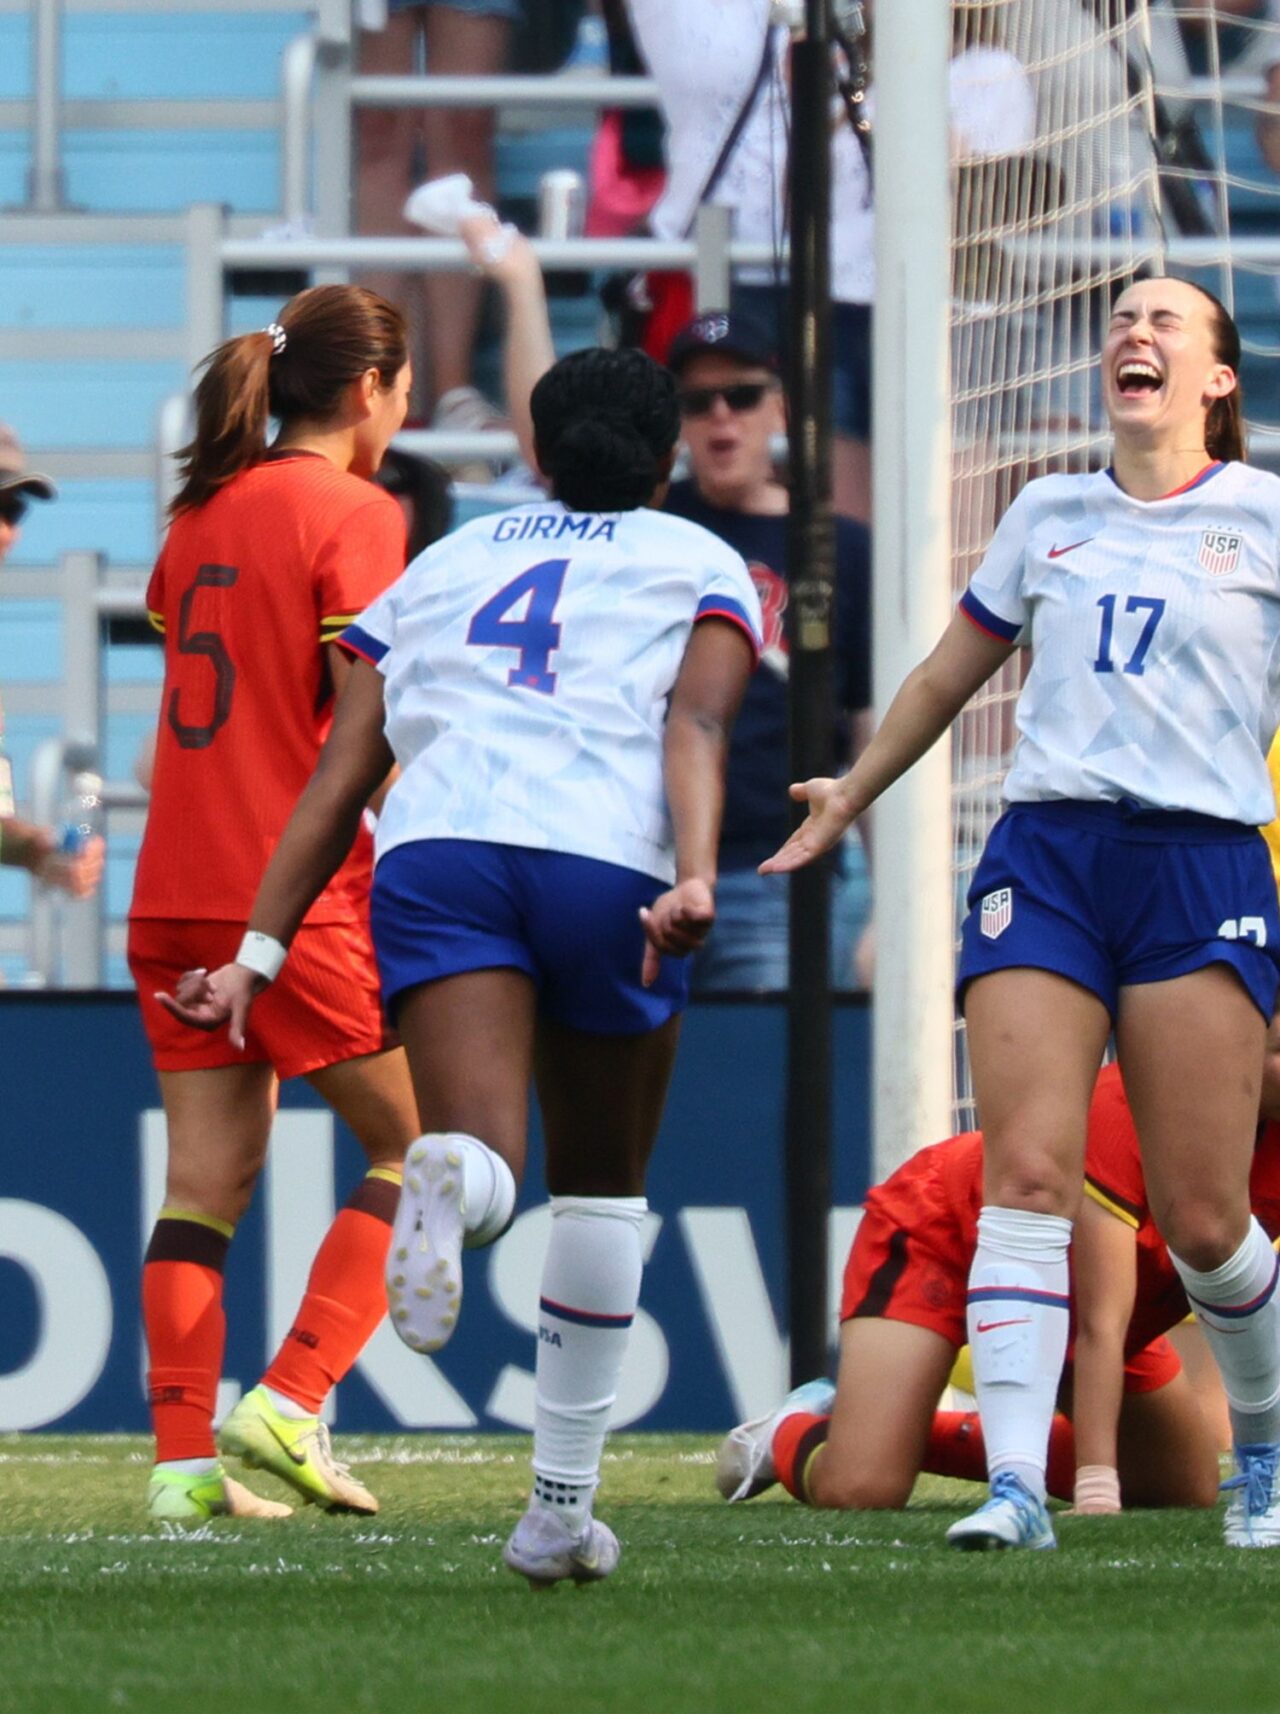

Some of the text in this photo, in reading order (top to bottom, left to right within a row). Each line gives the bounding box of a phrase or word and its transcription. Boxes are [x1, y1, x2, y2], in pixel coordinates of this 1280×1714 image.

[492, 514, 617, 543] GIRMA
[1204, 533, 1240, 554] USA
[465, 558, 572, 696] 4
[1093, 593, 1167, 676] 17
[167, 563, 240, 750] 5
[983, 890, 1010, 912] USA
